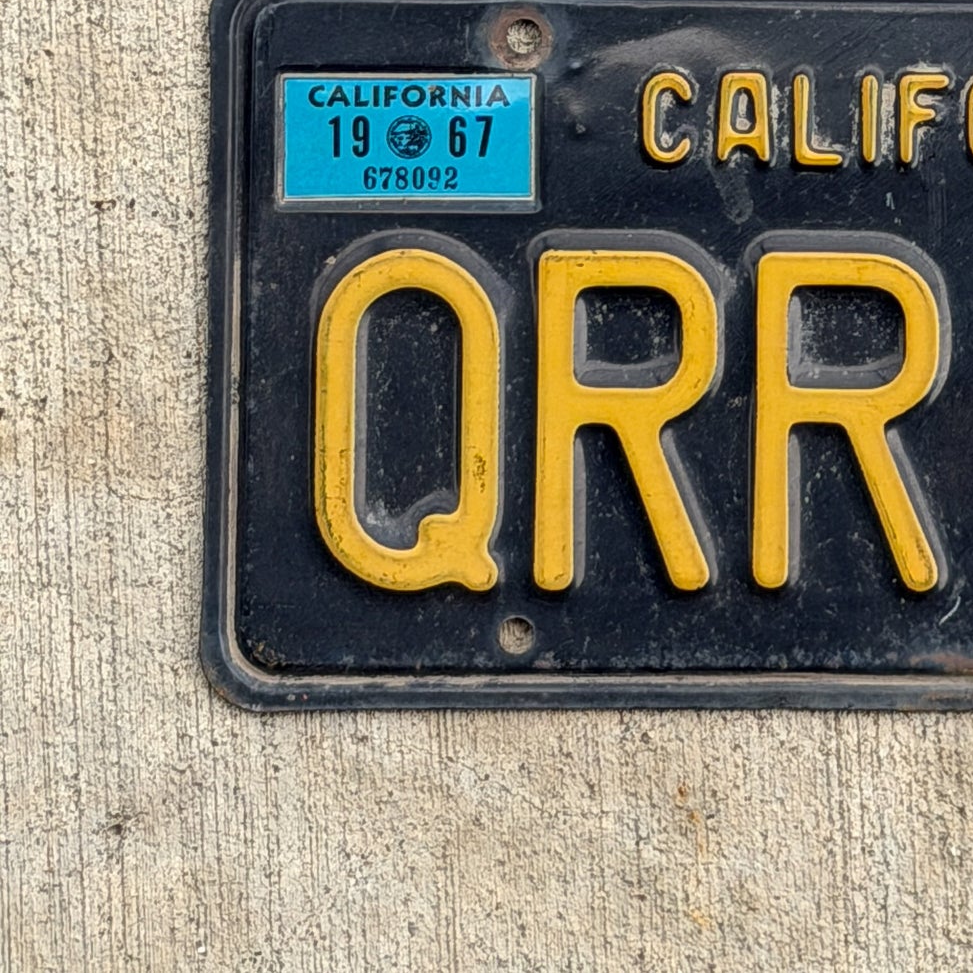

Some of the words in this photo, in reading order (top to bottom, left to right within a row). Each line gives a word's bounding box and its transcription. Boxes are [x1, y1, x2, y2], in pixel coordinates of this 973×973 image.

[309, 85, 511, 108] CALIFORNIA
[328, 115, 370, 158] 19
[449, 115, 494, 158] 67
[363, 166, 459, 190] 678092
[315, 250, 939, 594] QRR
